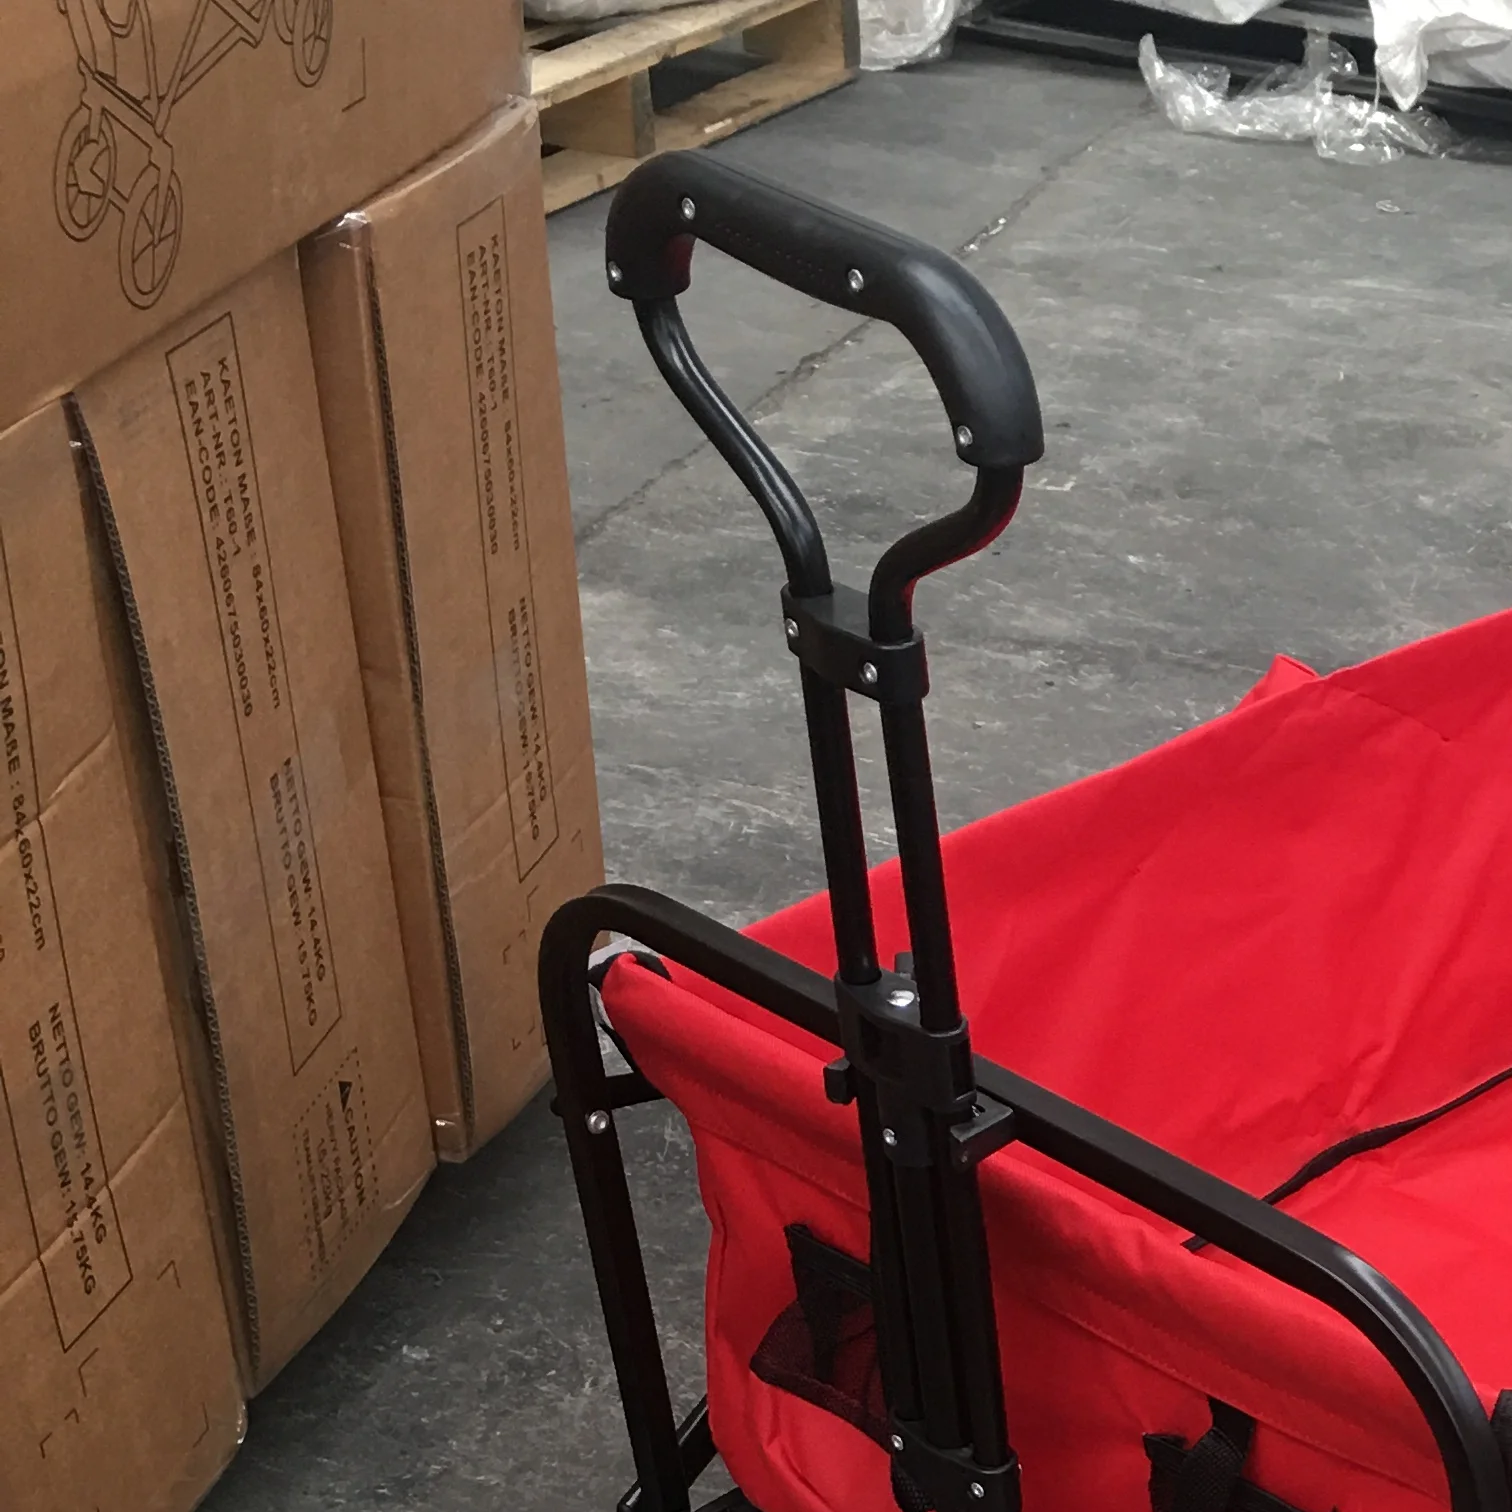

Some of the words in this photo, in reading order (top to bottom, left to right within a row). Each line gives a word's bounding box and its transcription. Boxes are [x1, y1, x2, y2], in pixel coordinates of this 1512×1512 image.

[48, 1002, 74, 1088] NETTO
[29, 1020, 58, 1126] BRUTTO
[51, 1130, 73, 1198] GEW:
[344, 1107, 366, 1206] CAUTION
